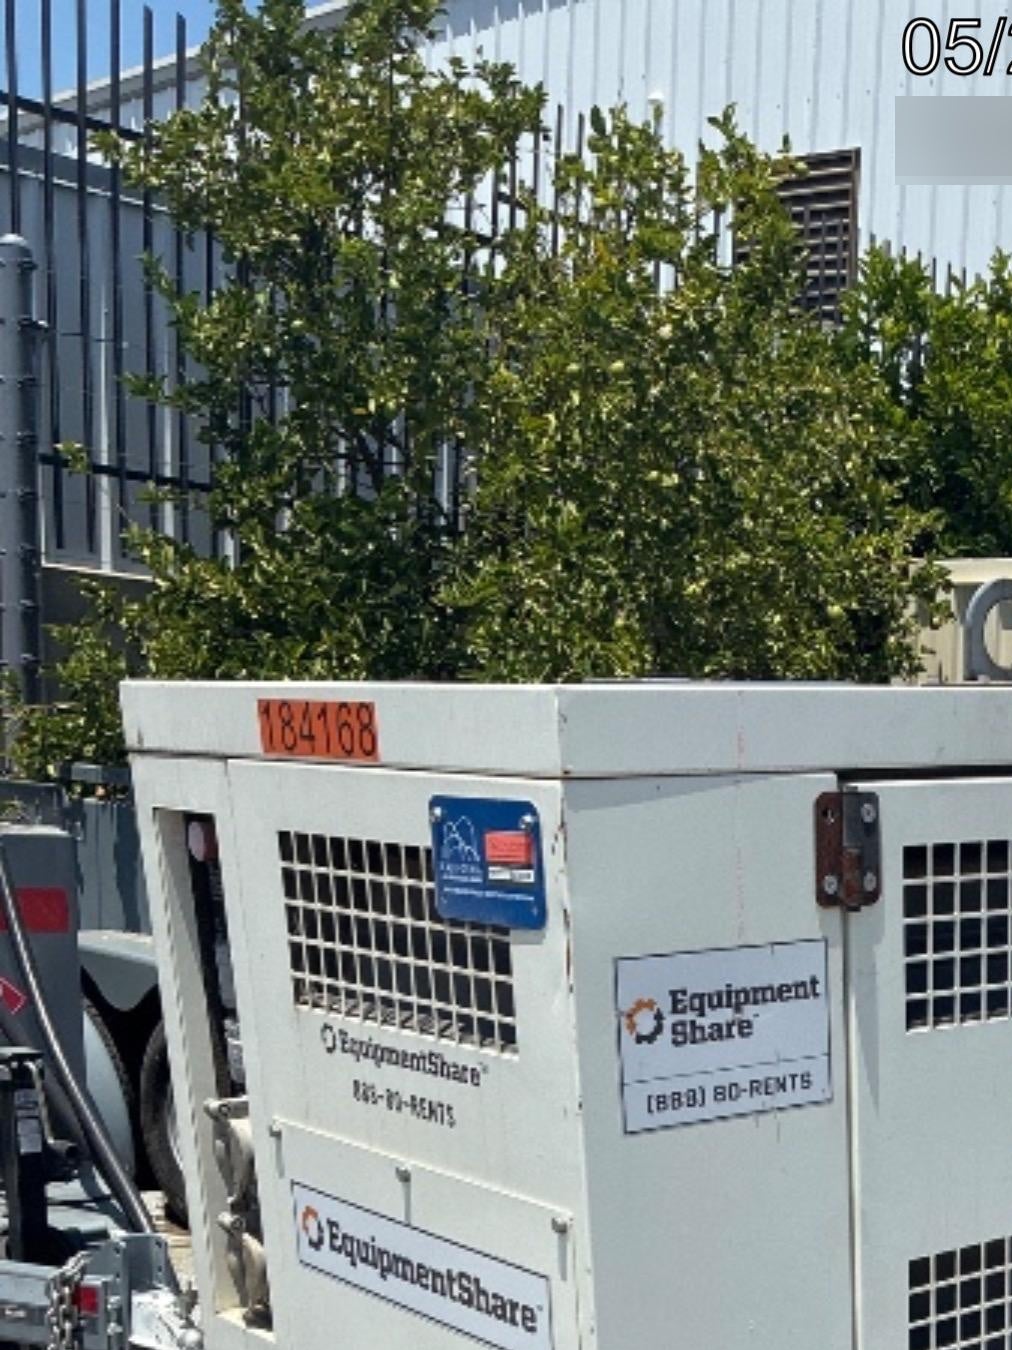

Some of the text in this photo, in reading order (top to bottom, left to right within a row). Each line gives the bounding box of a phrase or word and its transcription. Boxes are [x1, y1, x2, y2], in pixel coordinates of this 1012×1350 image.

[261, 700, 377, 757] 184168
[669, 975, 820, 1018] Equipment
[671, 1017, 754, 1047] Share
[326, 1217, 538, 1333] EquipmentShare
